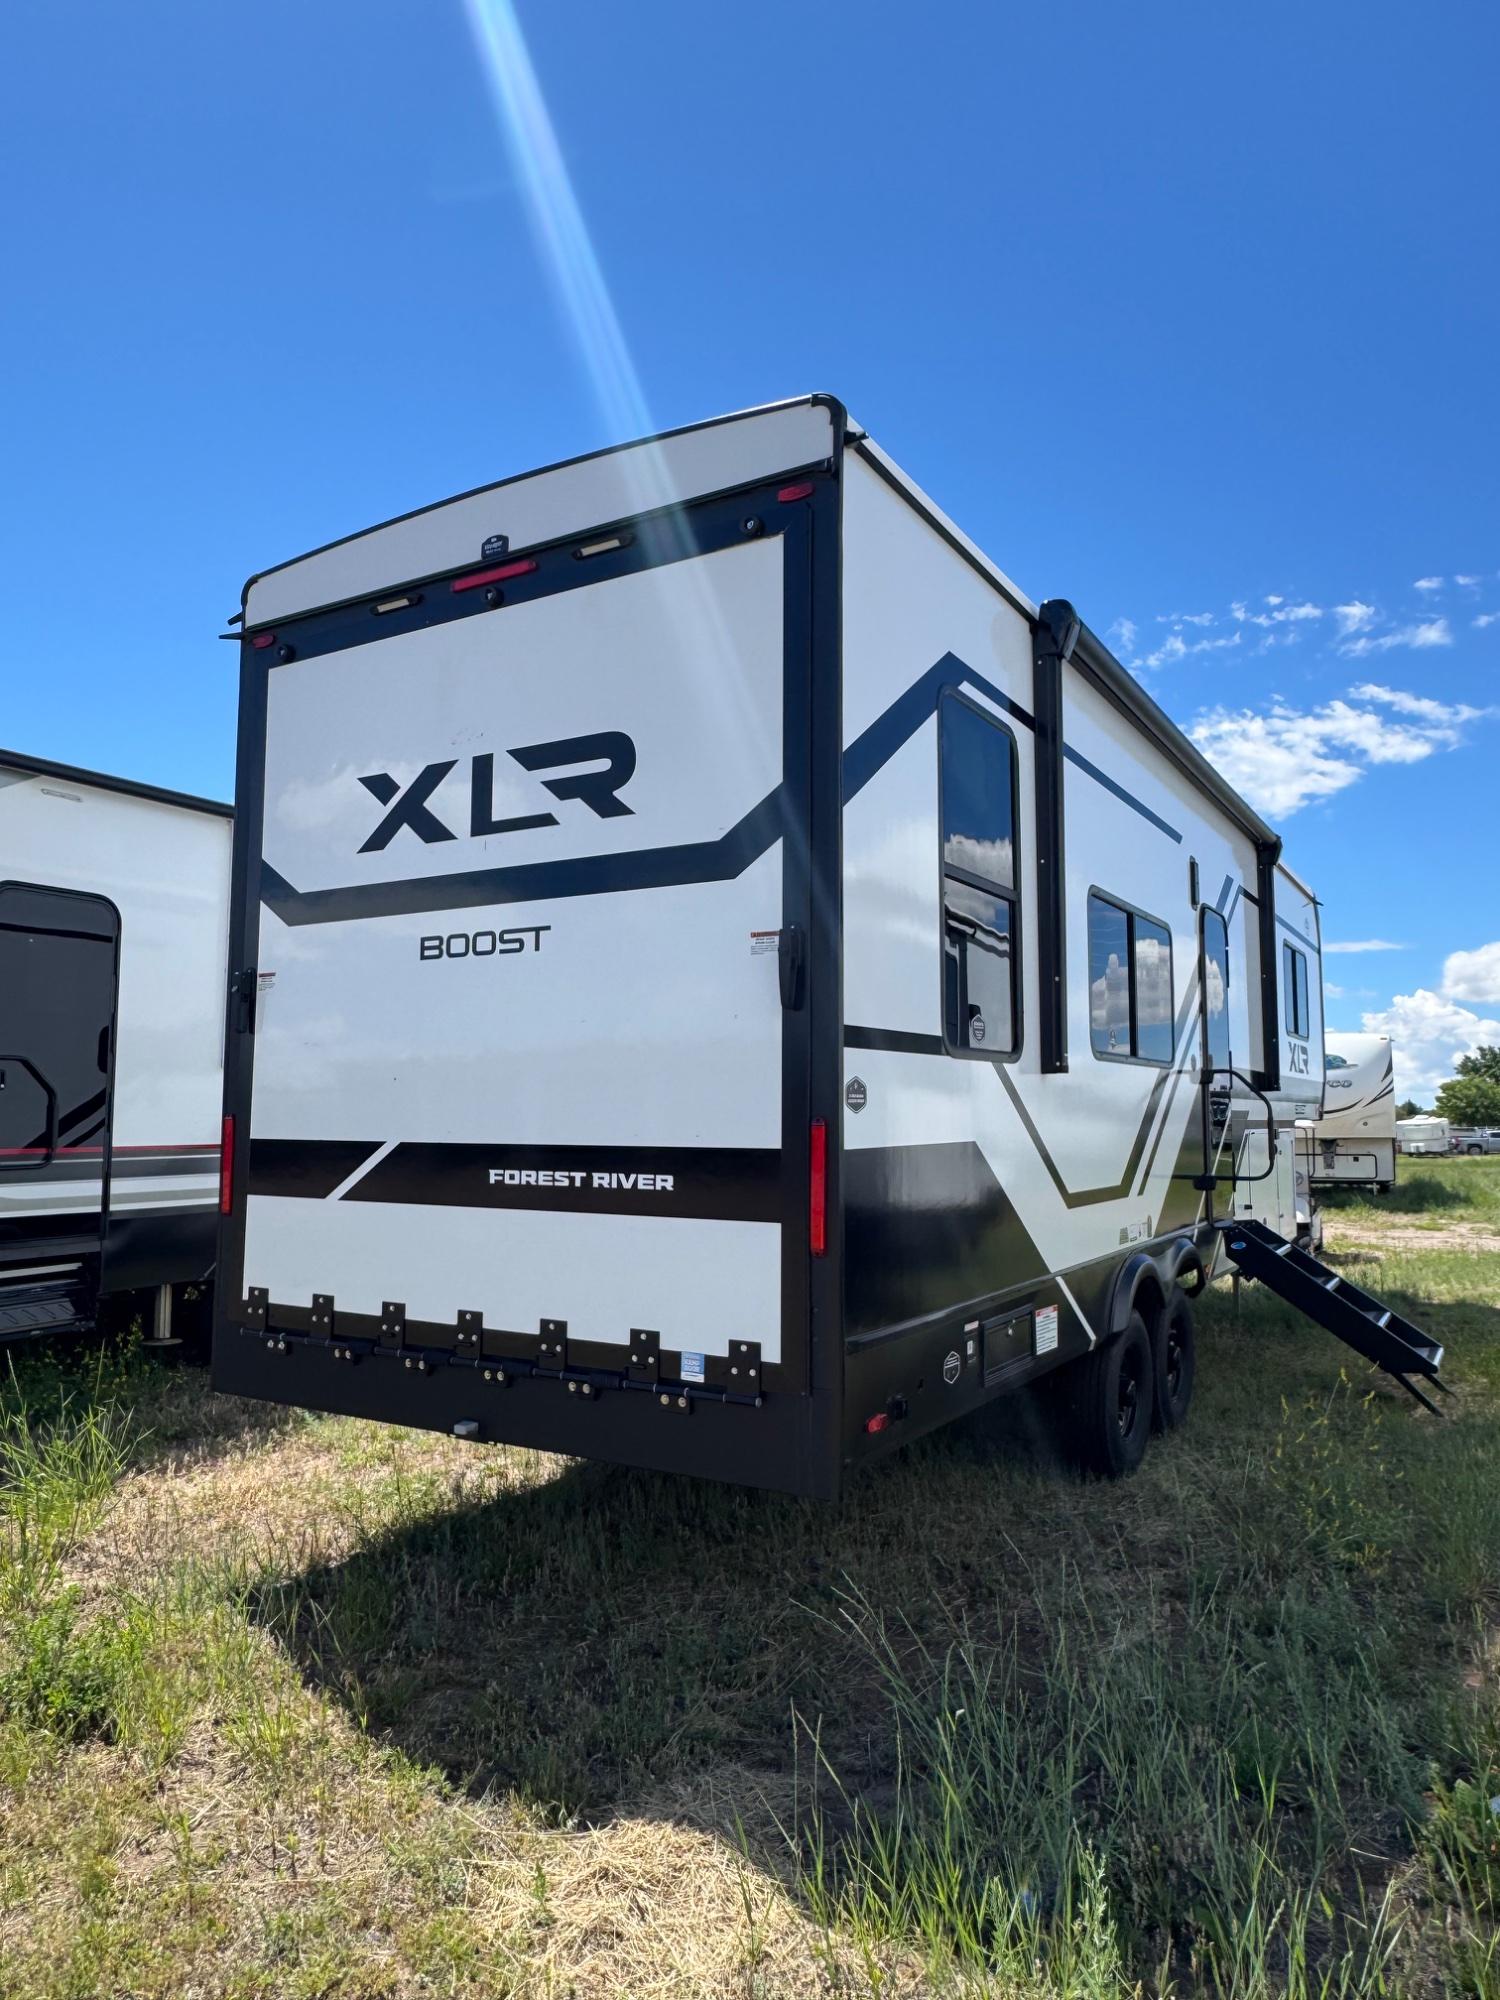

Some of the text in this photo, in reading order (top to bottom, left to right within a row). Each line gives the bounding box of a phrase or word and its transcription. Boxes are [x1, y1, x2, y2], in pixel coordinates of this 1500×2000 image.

[356, 730, 637, 855] XLR
[419, 925, 552, 961] BOOST
[1288, 1041, 1309, 1075] XLR
[489, 1169, 674, 1190] FOREST RIVER
